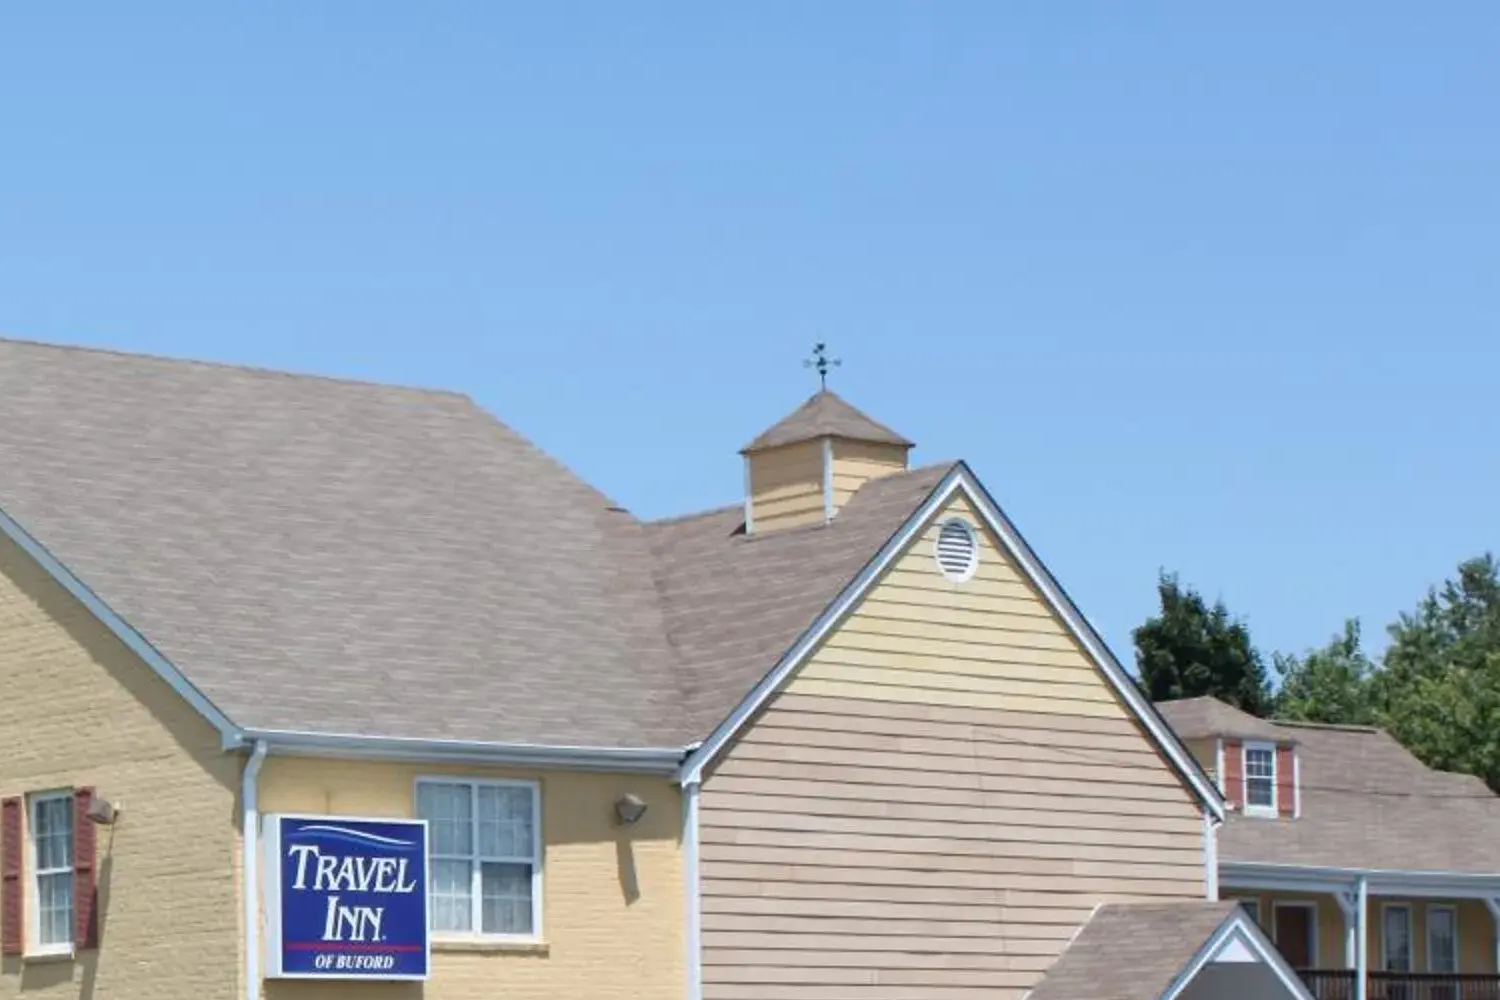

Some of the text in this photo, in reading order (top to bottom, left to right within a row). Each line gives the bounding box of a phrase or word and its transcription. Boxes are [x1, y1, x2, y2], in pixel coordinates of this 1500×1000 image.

[289, 844, 417, 893] TRAVEL
[320, 895, 385, 941] INN
[315, 954, 395, 969] OF BUFORD
